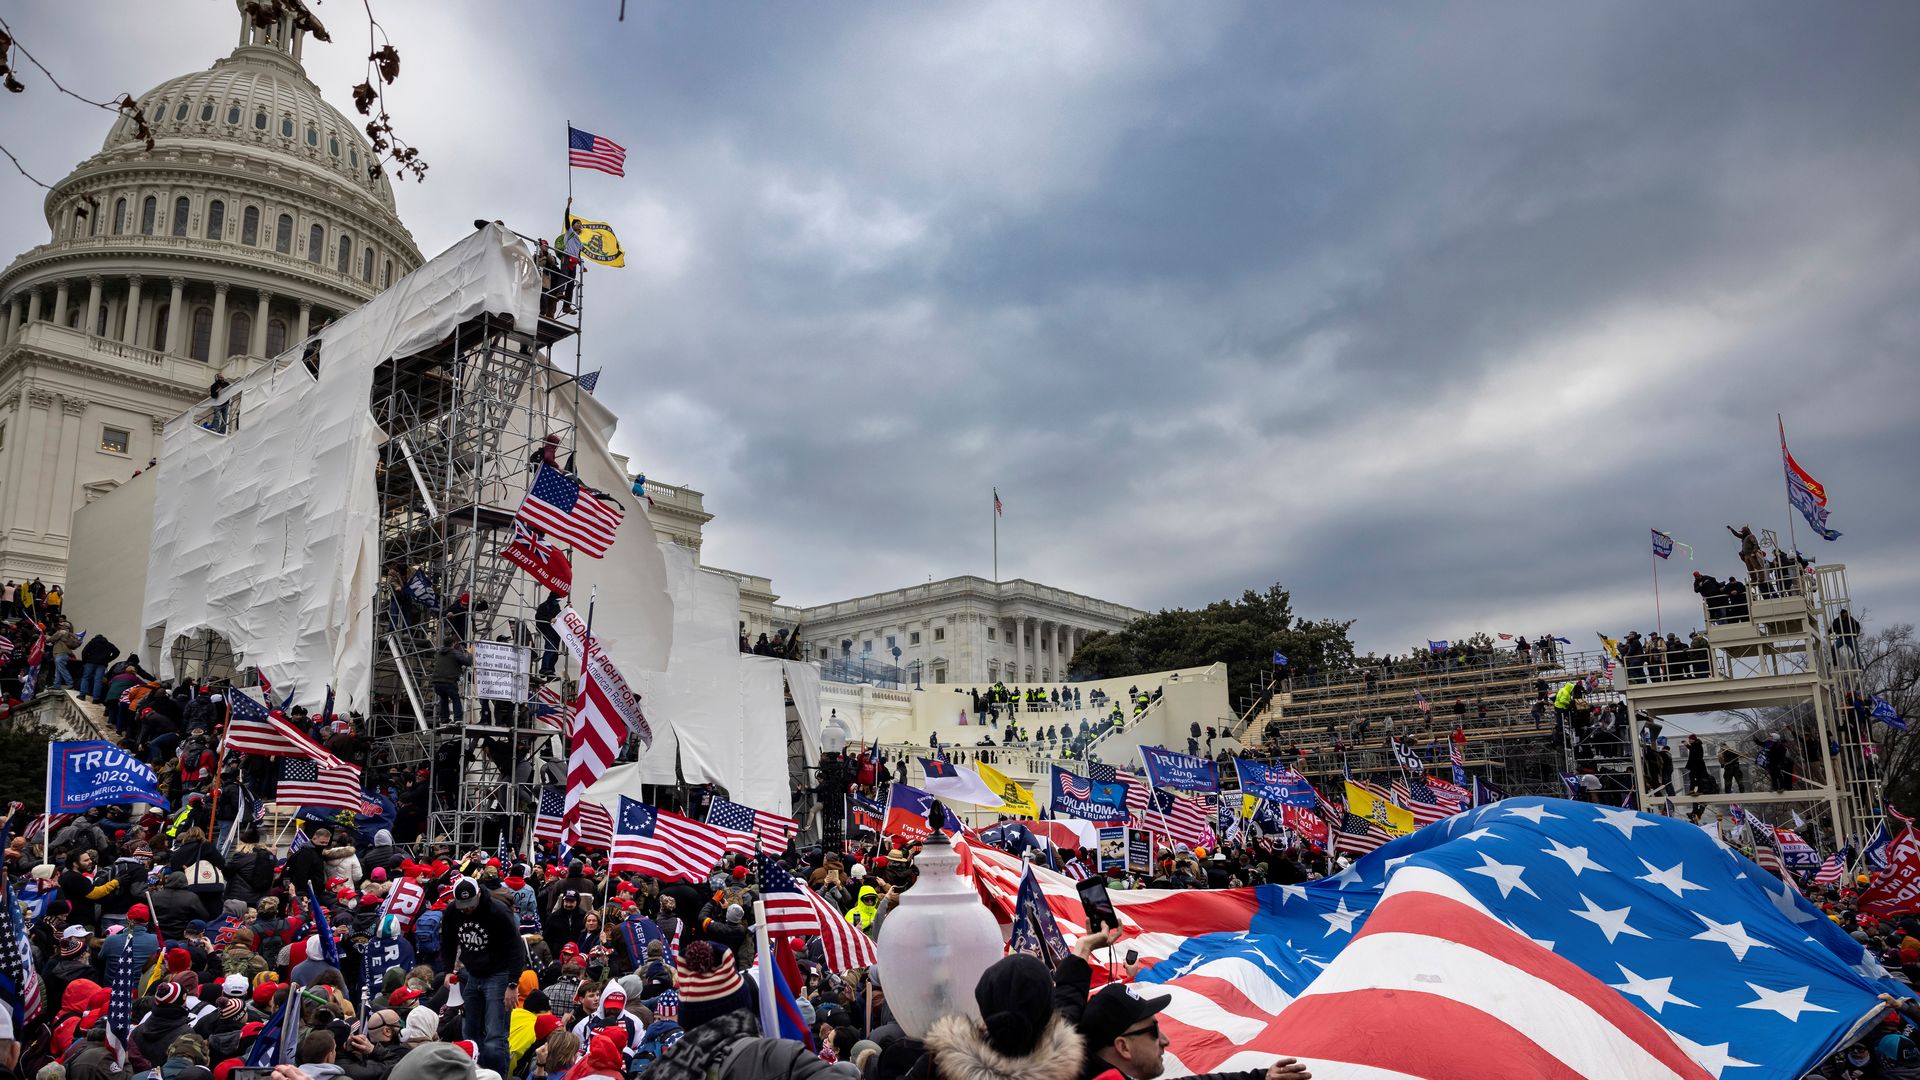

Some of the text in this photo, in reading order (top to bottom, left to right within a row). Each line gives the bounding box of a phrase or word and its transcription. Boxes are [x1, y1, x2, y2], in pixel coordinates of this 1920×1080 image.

[507, 546, 538, 568] LIBERTY
[537, 567, 550, 580] AND
[565, 633, 642, 733] Chines American Republicans
[596, 654, 623, 684] FIGHT
[618, 682, 635, 708] FOR
[69, 750, 159, 784] TRUMP
[1151, 751, 1209, 769] TRUMP
[67, 793, 90, 802] KEEP
[90, 785, 123, 799] AMERICA
[1062, 795, 1119, 815] OKLAHOMA
[1066, 807, 1112, 820] FOR TRUMP
[462, 932, 483, 946] 1776
[633, 922, 646, 944] KEEP
